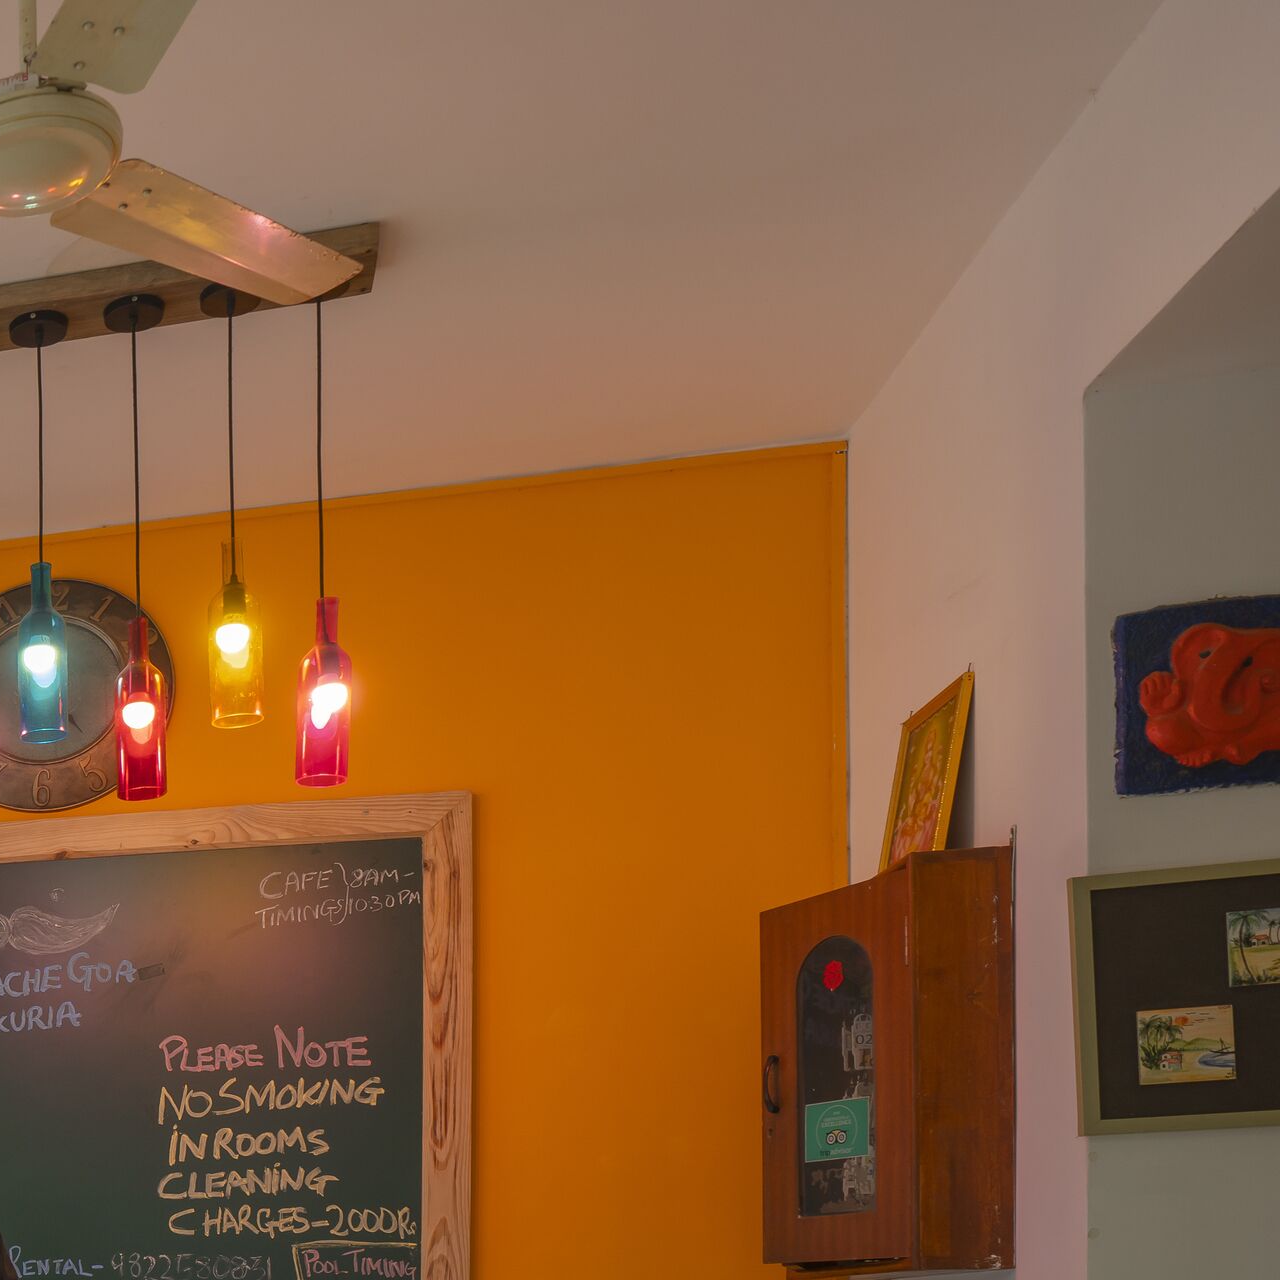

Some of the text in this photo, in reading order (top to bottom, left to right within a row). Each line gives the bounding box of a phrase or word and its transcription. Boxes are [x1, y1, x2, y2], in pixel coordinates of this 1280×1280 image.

[31, 769, 50, 807] 6
[78, 757, 107, 792] 5
[259, 869, 333, 899] CAFE
[255, 899, 342, 928] TIMINGS
[67, 952, 138, 992] GOA
[159, 1024, 372, 1072] PLEASE NOTE
[158, 1077, 385, 1125] NO SMOKING
[213, 1126, 330, 1159] ROOMS
[302, 1248, 416, 1280] POOL TIMING
